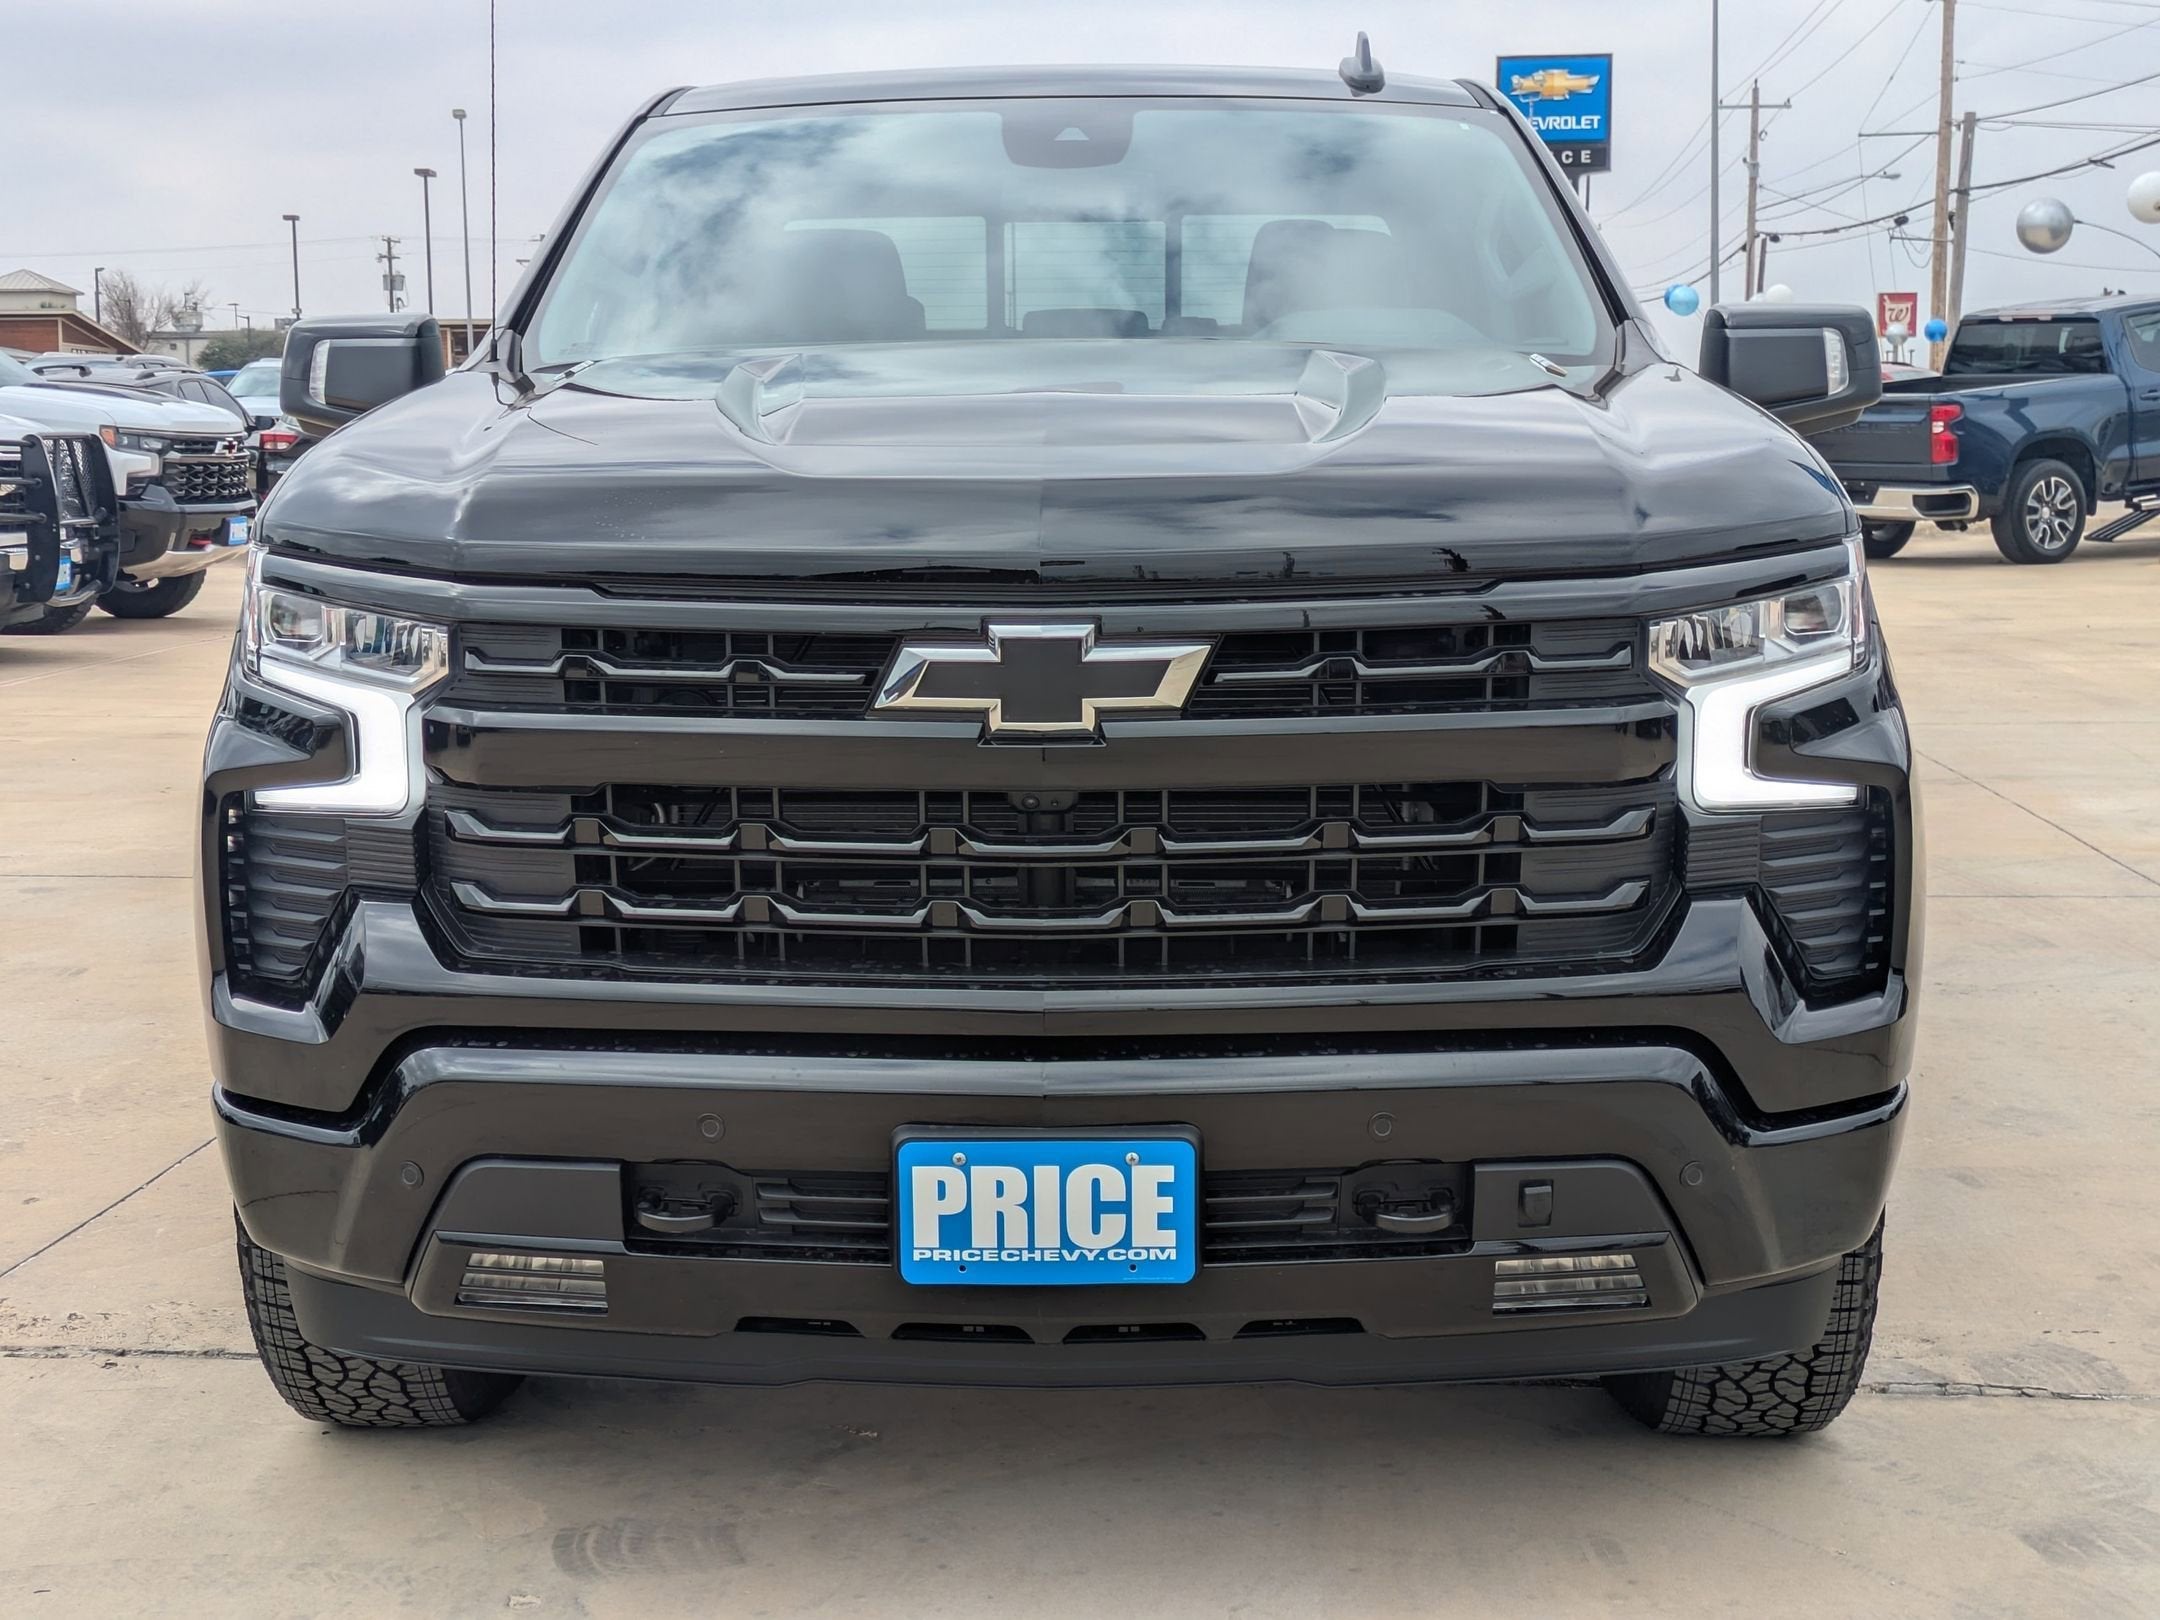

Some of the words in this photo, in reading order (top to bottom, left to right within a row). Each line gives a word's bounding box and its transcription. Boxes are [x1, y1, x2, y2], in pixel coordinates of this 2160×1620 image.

[1528, 115, 1602, 130] EVROLET
[911, 1163, 1177, 1249] PRICE
[912, 1248, 1177, 1262] PRICECHEVY.COM
